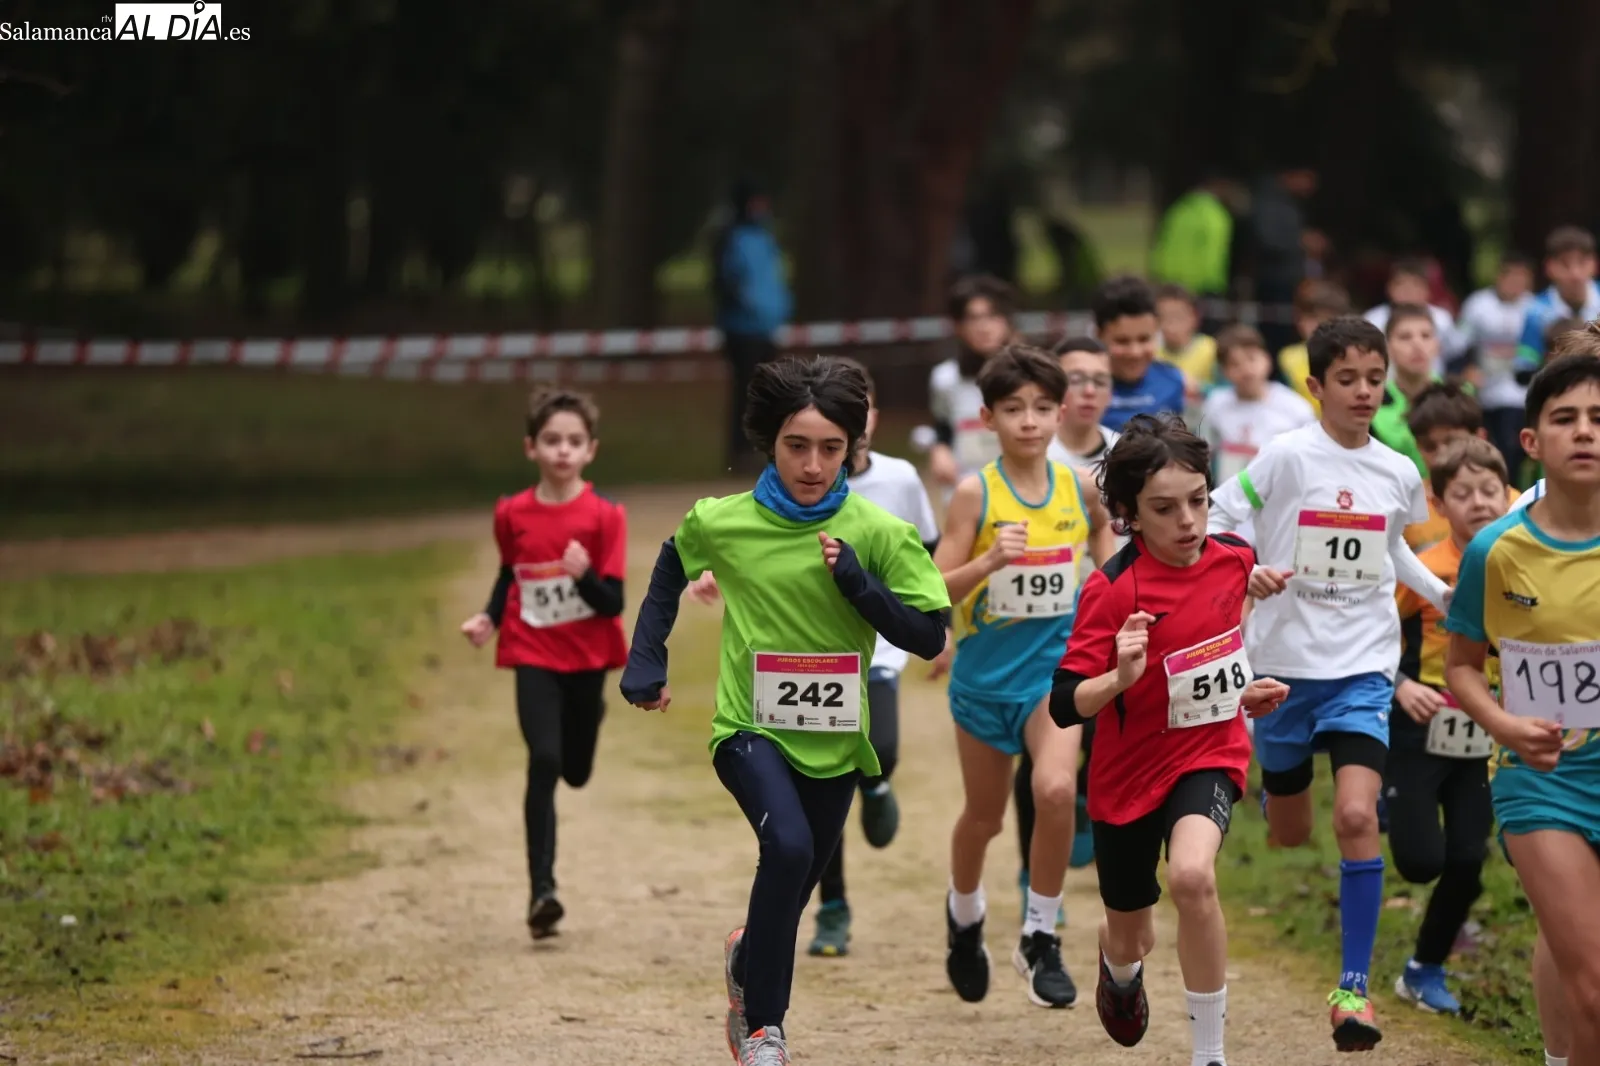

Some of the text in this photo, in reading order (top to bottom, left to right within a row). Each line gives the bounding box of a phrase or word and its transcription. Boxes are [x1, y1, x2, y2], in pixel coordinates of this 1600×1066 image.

[1325, 536, 1362, 561] 10
[1010, 572, 1064, 597] 199
[1545, 645, 1556, 656] de
[1192, 662, 1246, 701] 518
[1516, 658, 1600, 704] 198
[777, 681, 844, 707] 242
[1443, 716, 1489, 739] 11
